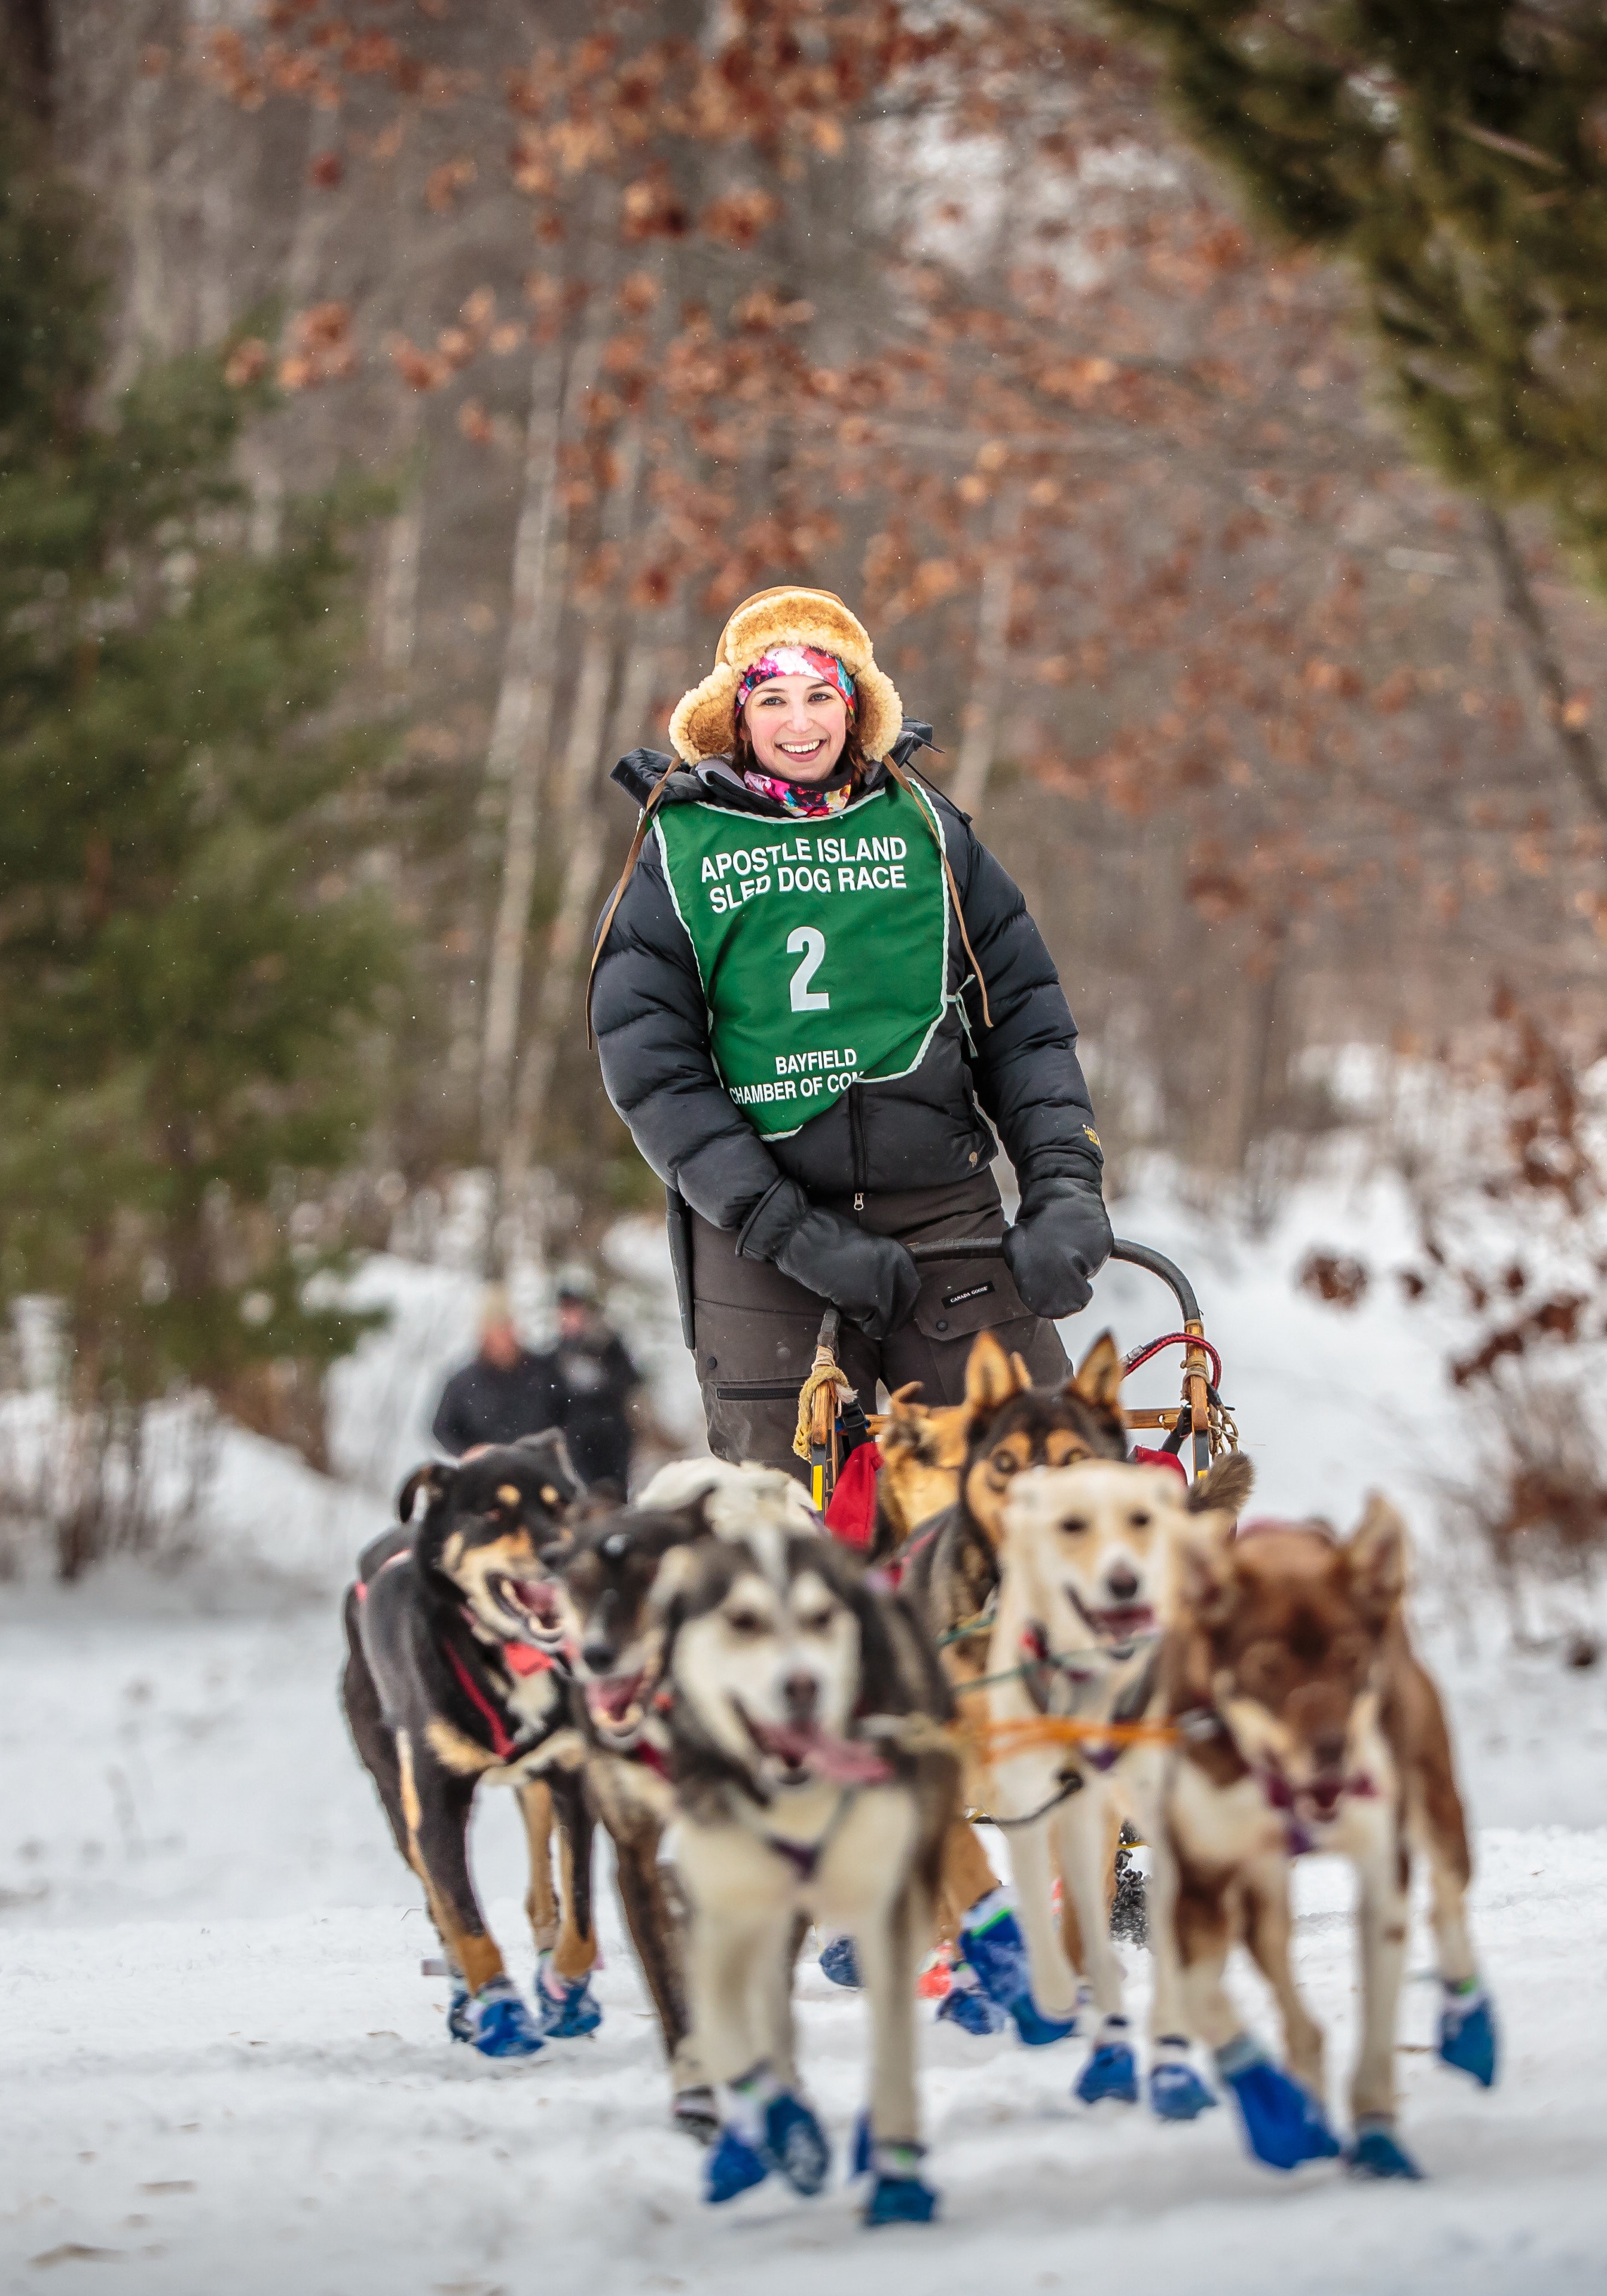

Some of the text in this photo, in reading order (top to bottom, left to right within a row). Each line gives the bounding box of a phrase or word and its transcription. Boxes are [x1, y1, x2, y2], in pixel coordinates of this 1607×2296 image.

[701, 836, 907, 883] APOSTLE ISLAND
[709, 865, 907, 914] SLED DOG RACE
[786, 926, 830, 1013] 2
[775, 1048, 857, 1075] BAYFIELD
[729, 1080, 797, 1104] CHAMBER
[800, 1076, 823, 1097] OF
[950, 1286, 988, 1303] CANADA GOOSE
